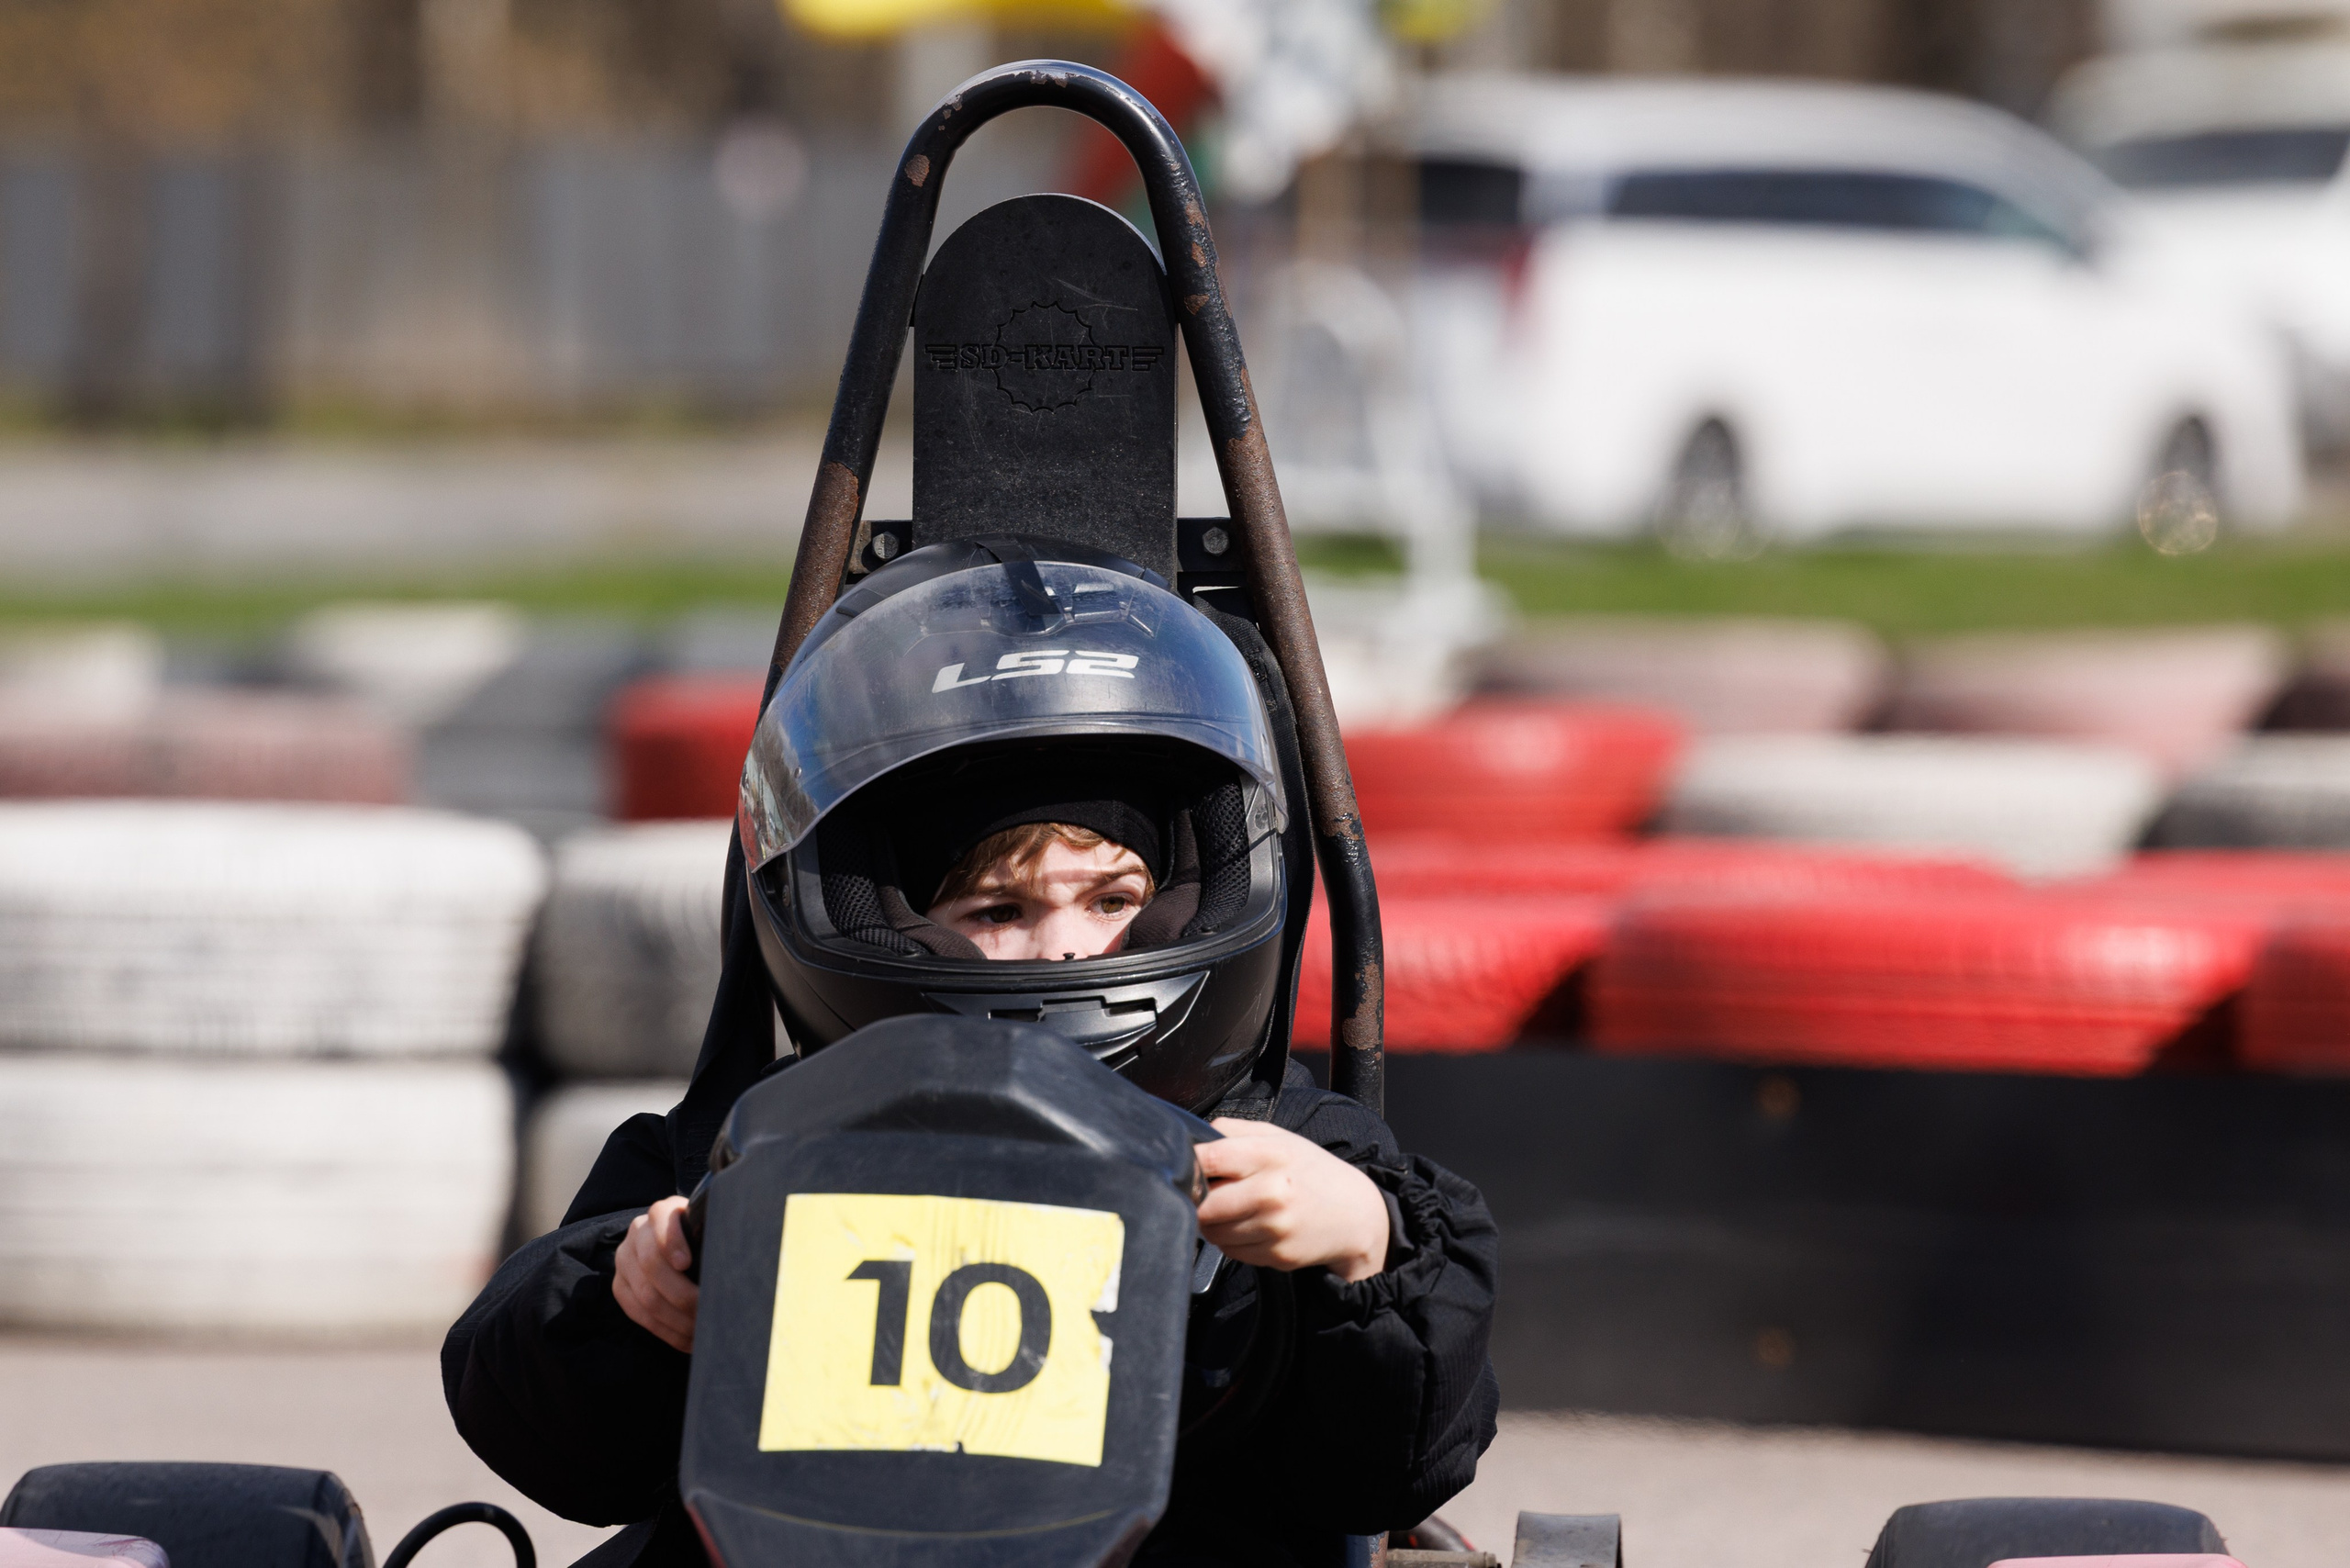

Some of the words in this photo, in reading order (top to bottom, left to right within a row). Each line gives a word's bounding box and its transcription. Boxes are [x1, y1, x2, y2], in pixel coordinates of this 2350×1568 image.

[959, 343, 1129, 370] SD-KART
[932, 650, 1139, 693] LS2
[845, 1260, 1052, 1394] 10
